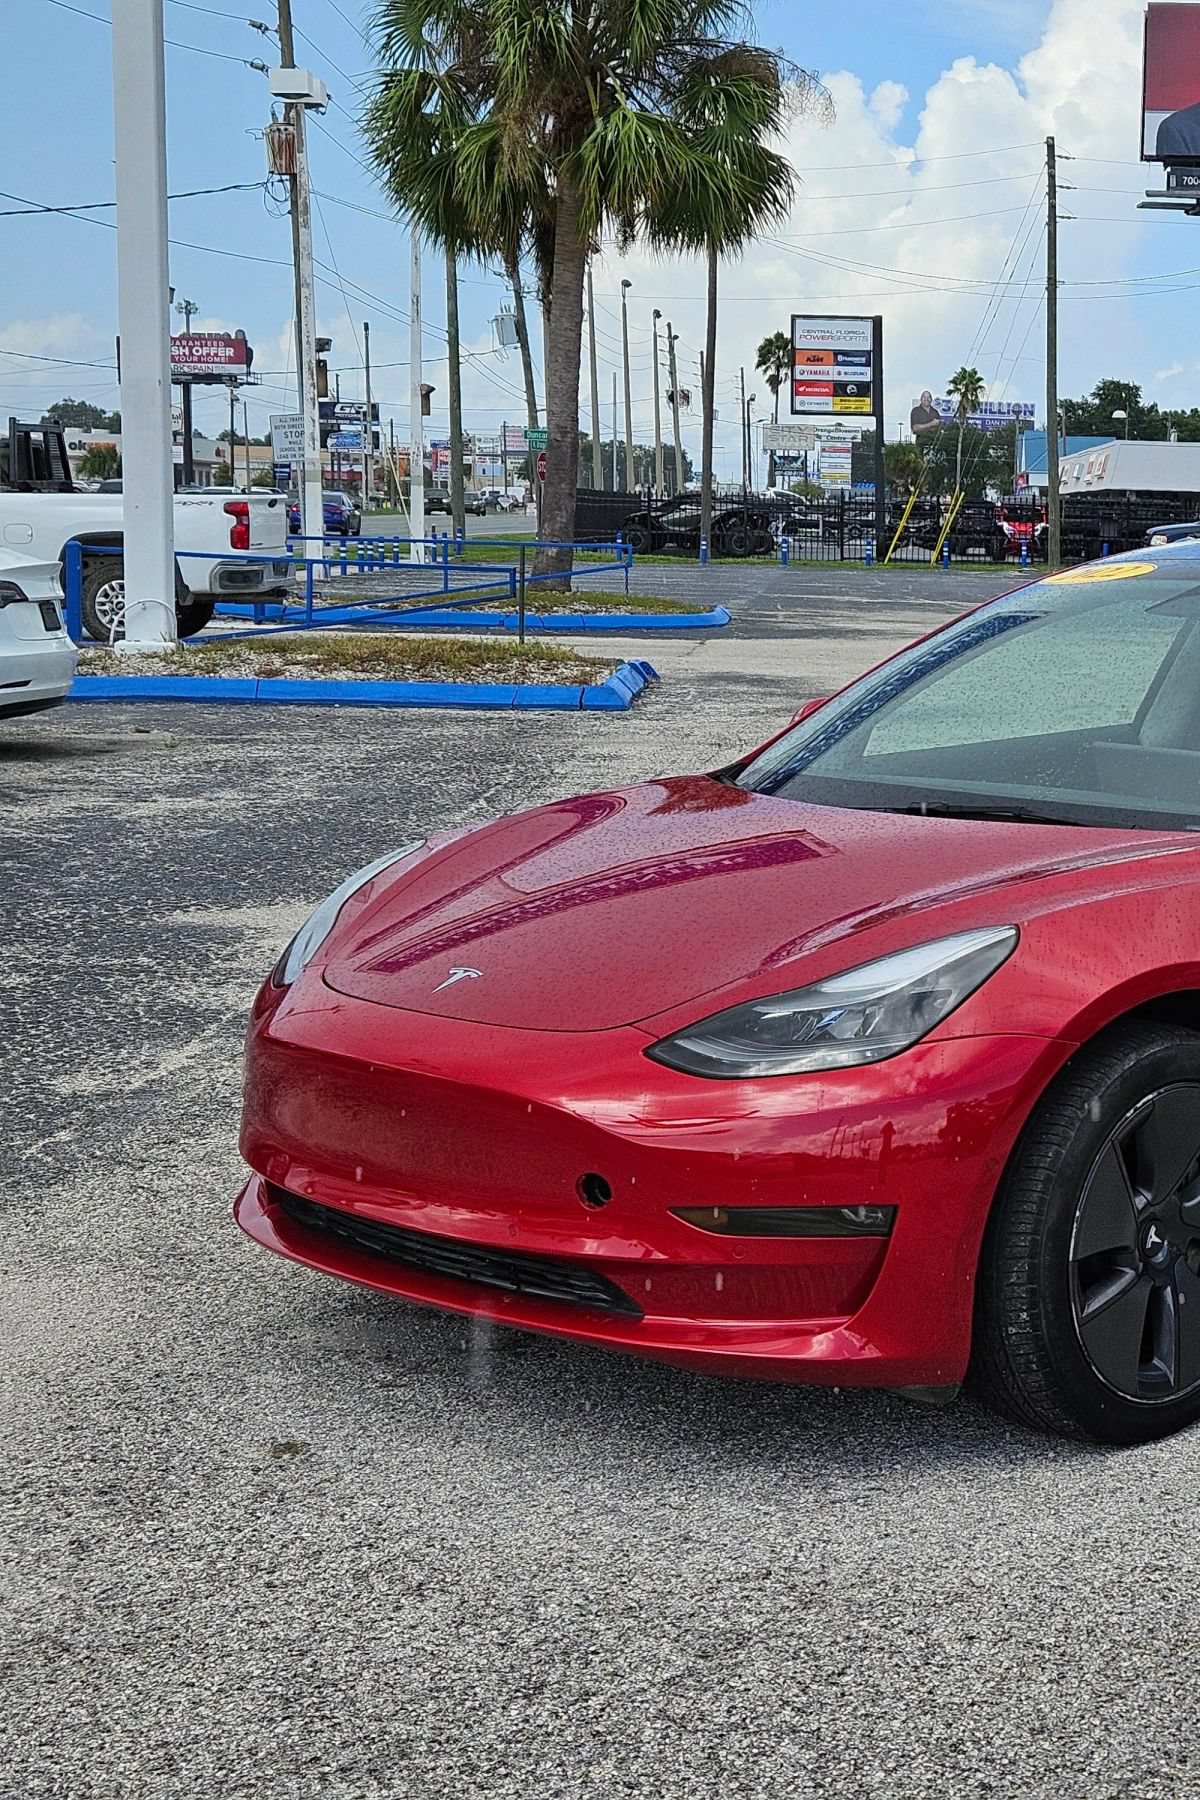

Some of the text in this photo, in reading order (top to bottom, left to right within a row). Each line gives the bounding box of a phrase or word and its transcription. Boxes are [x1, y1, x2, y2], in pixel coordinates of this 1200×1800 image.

[170, 346, 235, 357] SH OFFER
[283, 430, 305, 439] STOP
[768, 434, 809, 443] STAR
